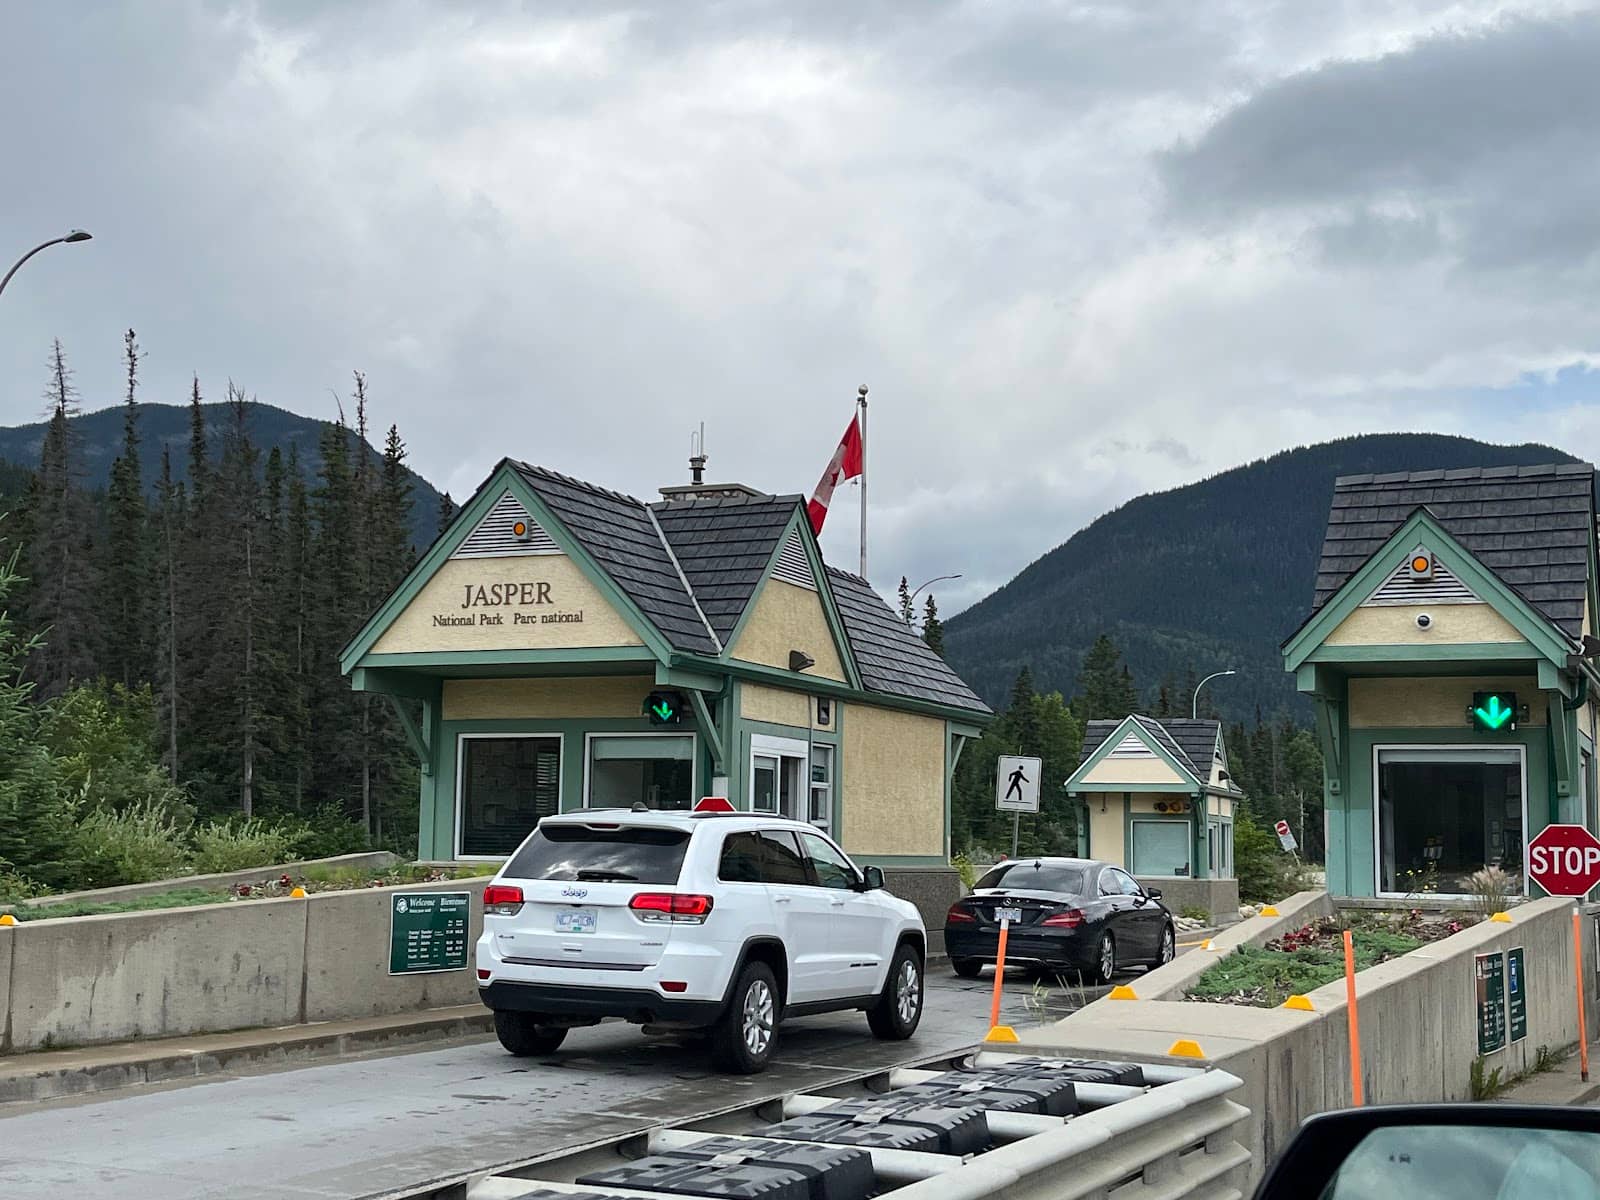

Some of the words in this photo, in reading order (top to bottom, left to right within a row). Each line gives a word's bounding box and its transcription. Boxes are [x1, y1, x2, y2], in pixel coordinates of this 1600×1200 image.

[462, 582, 553, 608] JASPER
[432, 613, 475, 626] National
[480, 613, 504, 625] Park
[514, 612, 537, 625] Parc
[541, 610, 583, 624] national
[1531, 846, 1600, 875] STOP
